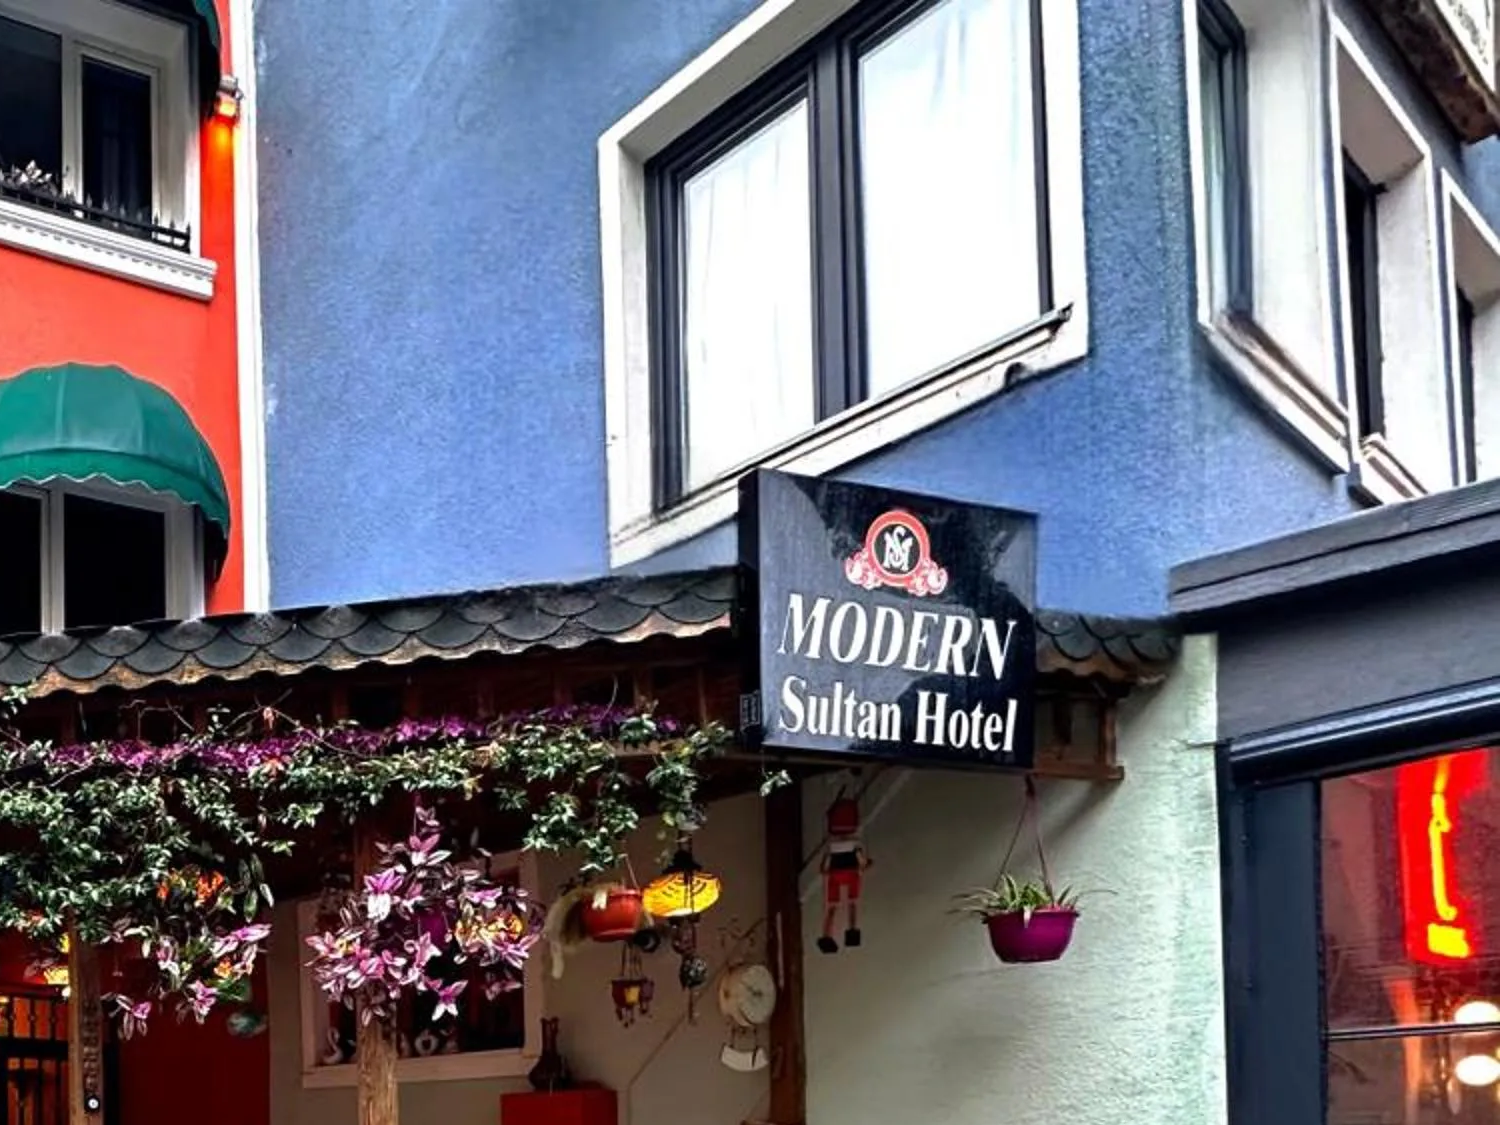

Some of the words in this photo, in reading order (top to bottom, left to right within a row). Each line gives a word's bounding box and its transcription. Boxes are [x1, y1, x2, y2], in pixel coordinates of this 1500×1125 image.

[777, 593, 1018, 681] MODERN
[778, 675, 901, 742] Sultan
[913, 690, 1018, 752] Hotel
